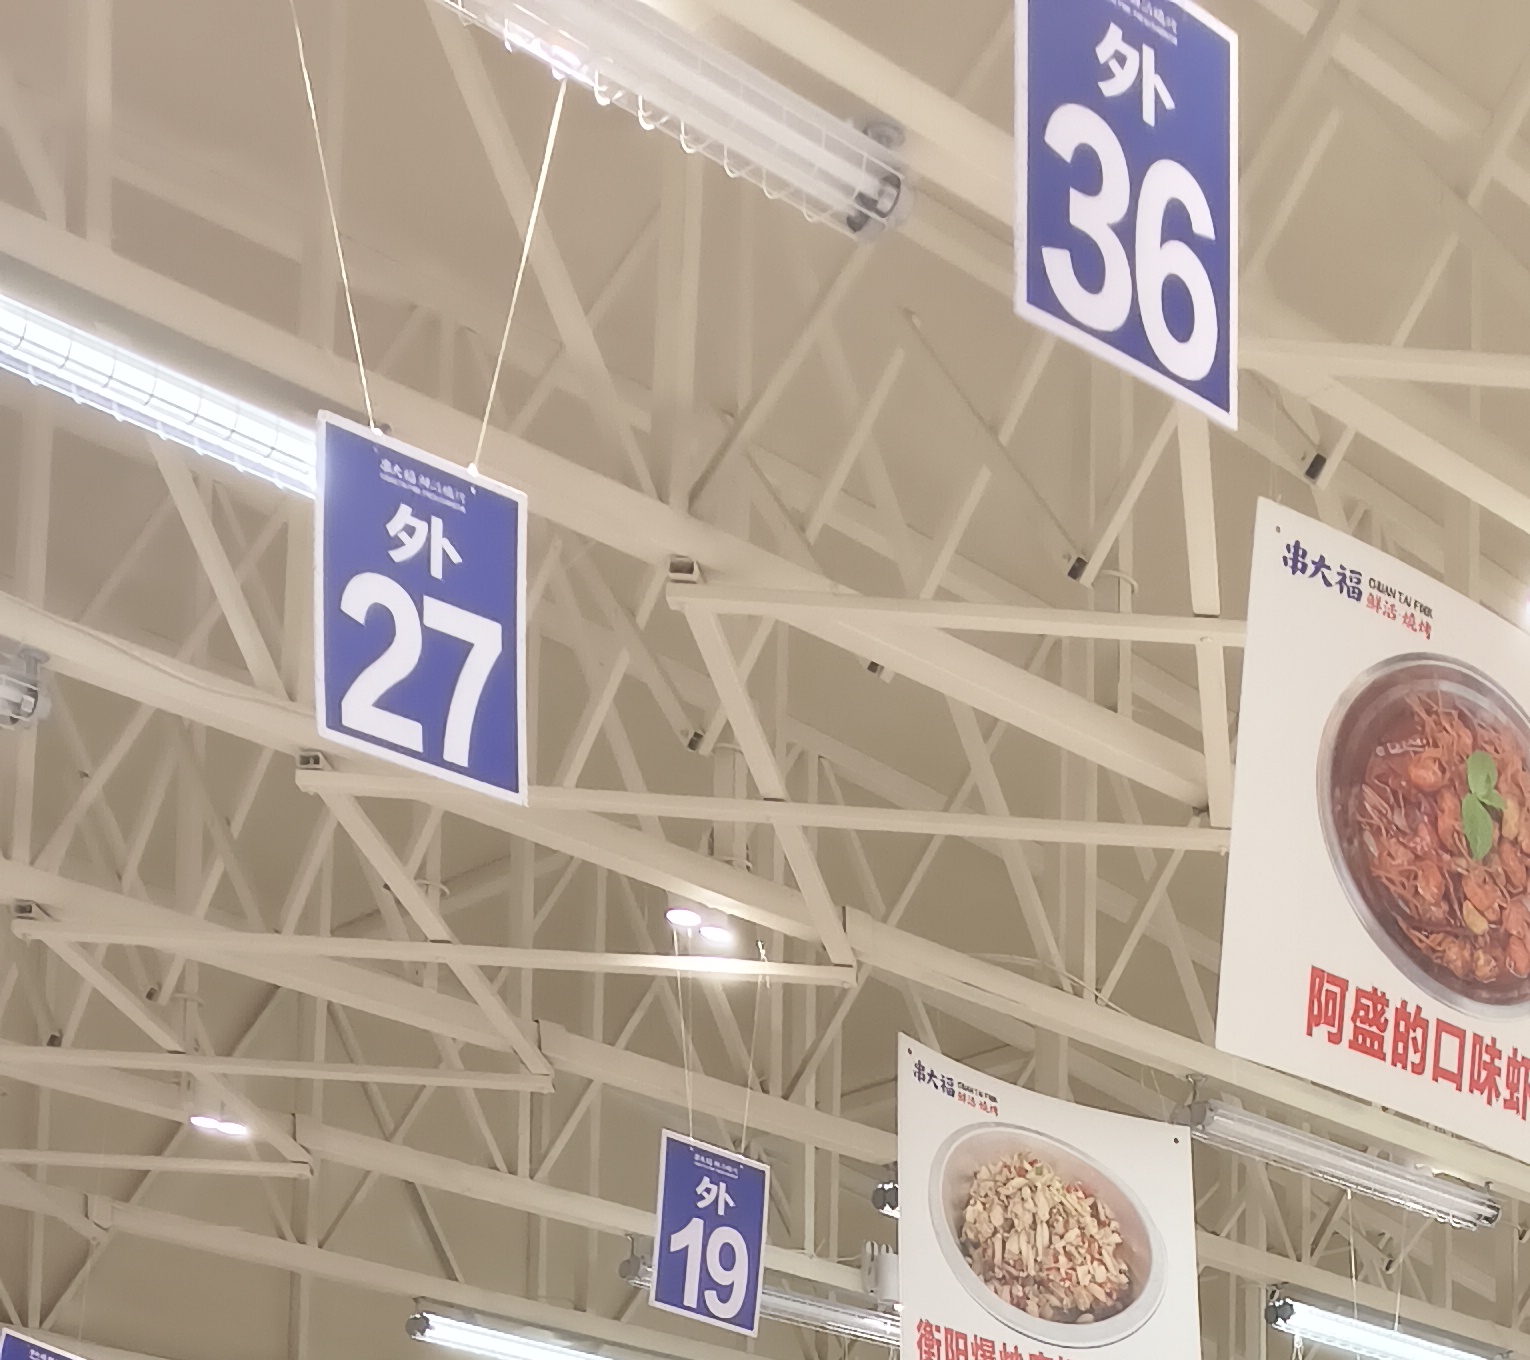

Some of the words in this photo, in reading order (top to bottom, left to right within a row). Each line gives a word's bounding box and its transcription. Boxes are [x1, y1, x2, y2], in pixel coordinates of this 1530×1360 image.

[1095, 22, 1175, 127] 外
[1042, 103, 1218, 381] 36
[386, 503, 462, 580] 外
[1282, 540, 1363, 602] 串大福
[340, 572, 502, 767] 27
[913, 1060, 955, 1097] 串大福
[695, 1175, 736, 1216] 外
[670, 1218, 749, 1319] 19
